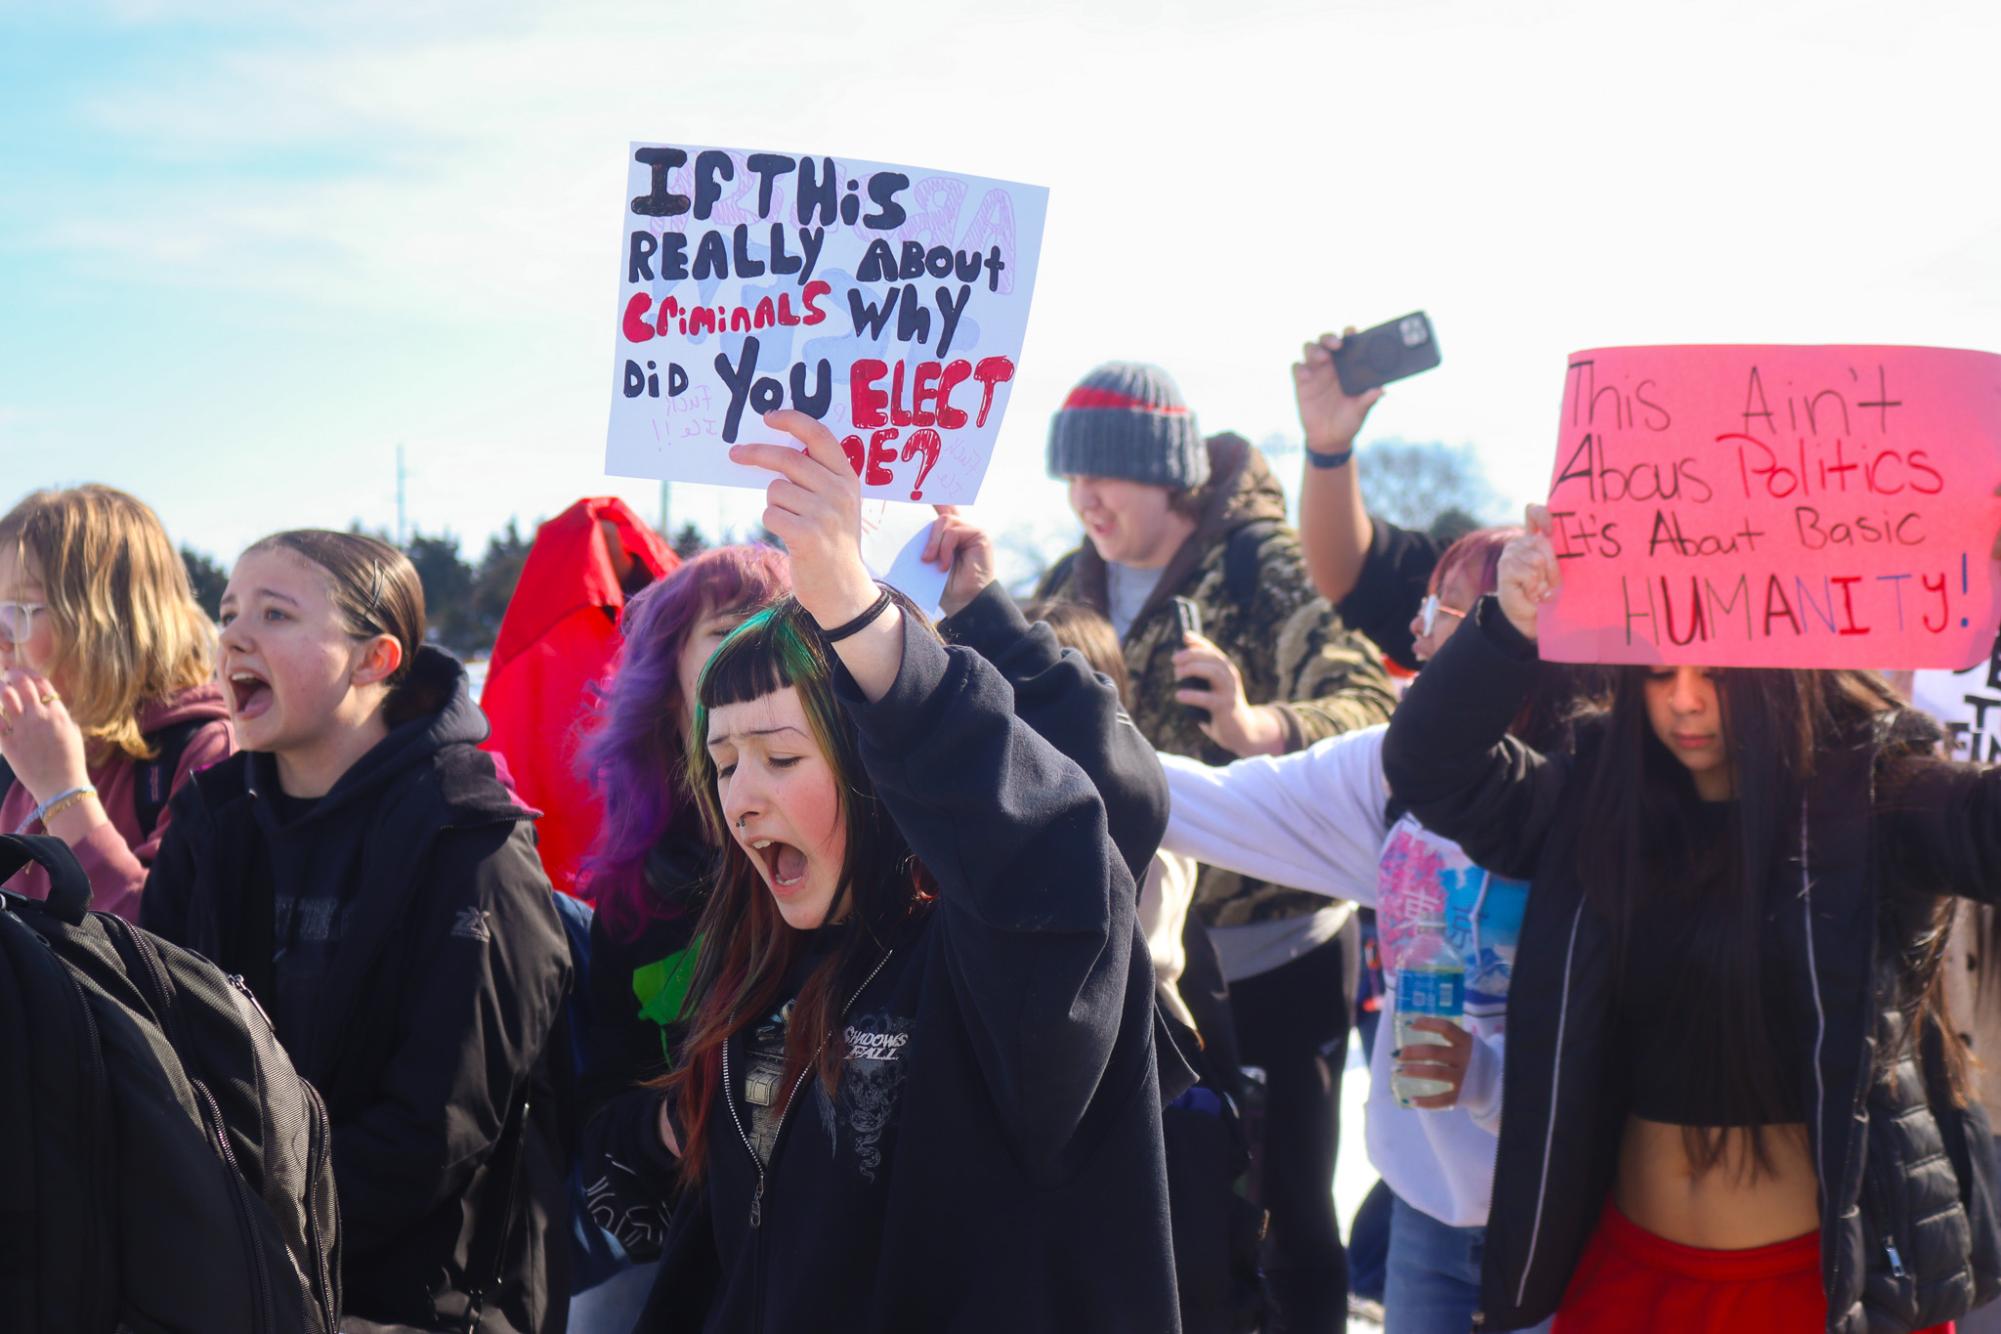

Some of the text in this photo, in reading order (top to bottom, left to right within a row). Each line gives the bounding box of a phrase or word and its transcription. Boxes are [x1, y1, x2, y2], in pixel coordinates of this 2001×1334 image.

[849, 355, 1015, 430] ELECT
[1569, 360, 1902, 436] This Ain't
[802, 428, 941, 500] E?
[1715, 433, 1944, 499] Politics
[1550, 506, 1926, 559] It's About Basic
